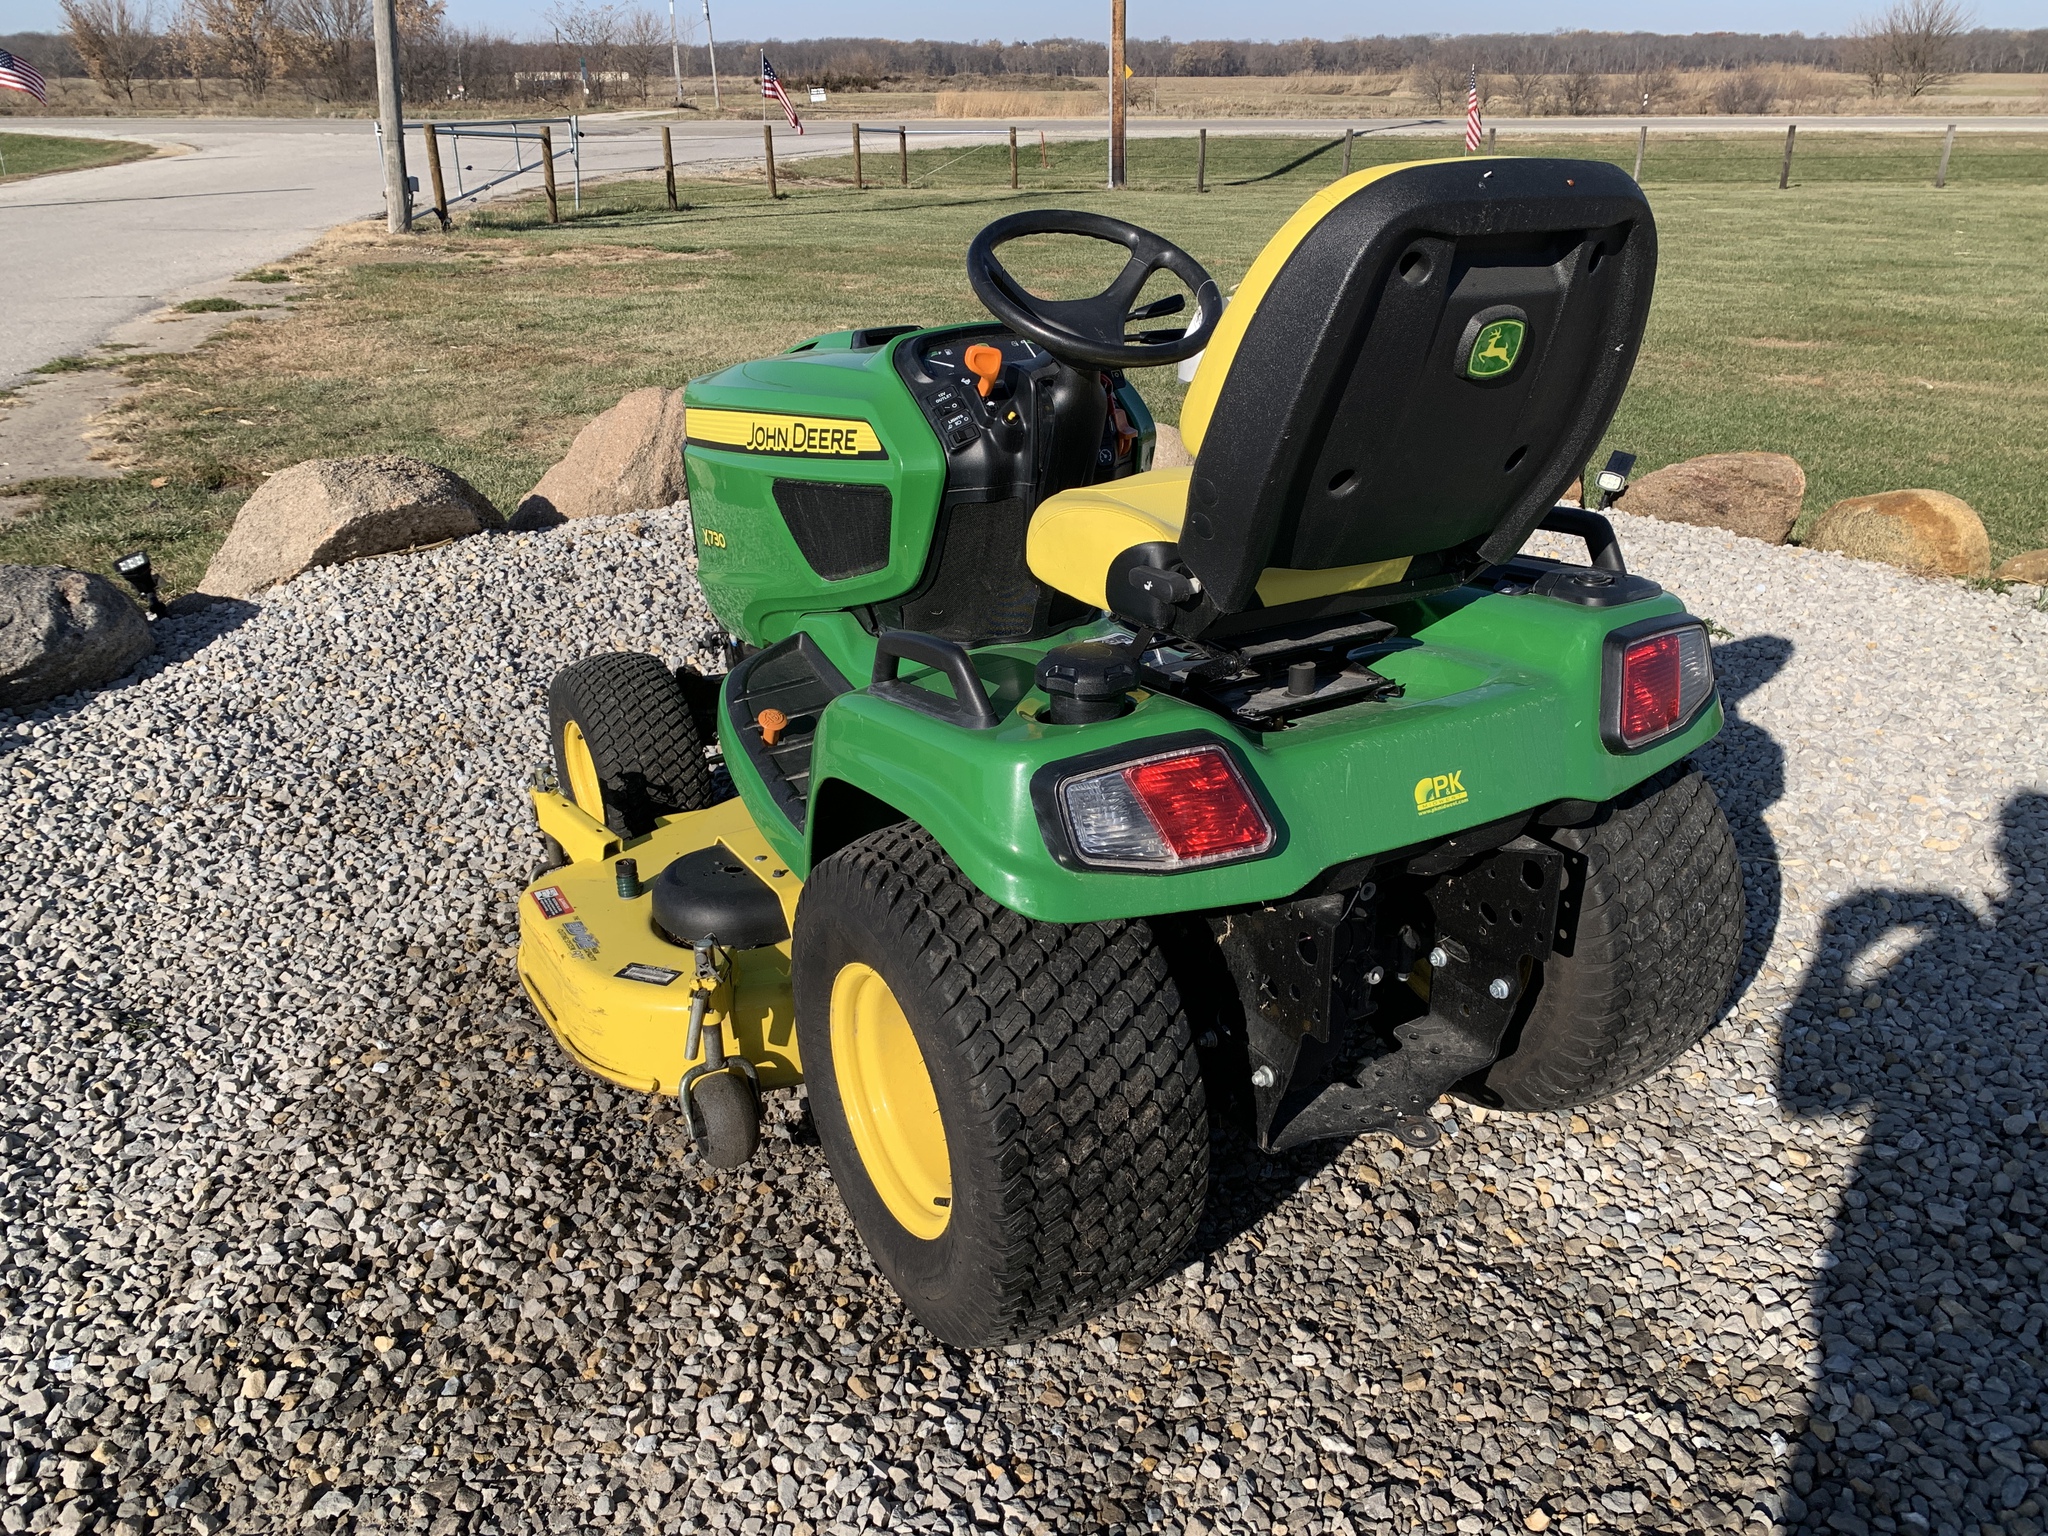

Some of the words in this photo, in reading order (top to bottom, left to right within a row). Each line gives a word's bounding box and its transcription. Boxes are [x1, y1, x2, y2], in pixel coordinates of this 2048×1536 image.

[935, 393, 952, 403] OUTLET
[947, 414, 964, 424] LIGHTS
[746, 422, 788, 447] JOHN
[793, 422, 858, 451] DEERE
[702, 527, 727, 549] X730
[562, 921, 599, 950] EDGE
